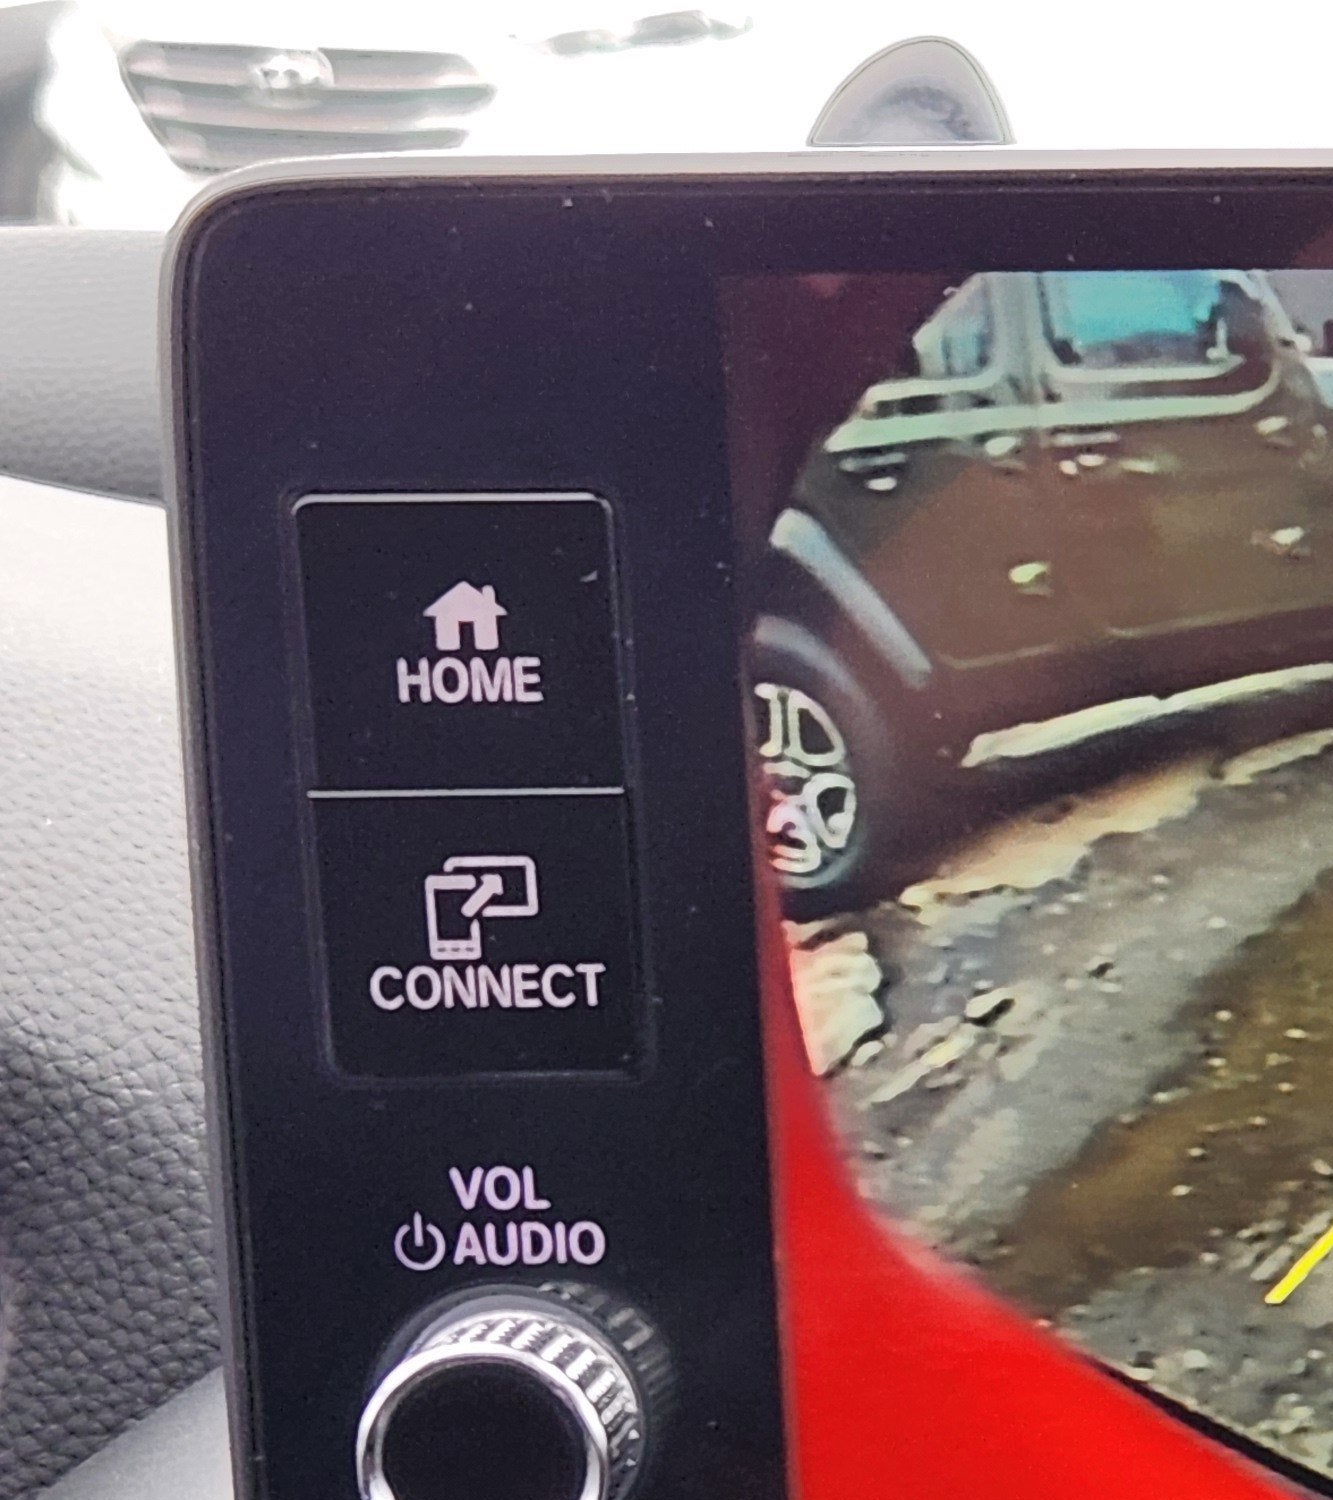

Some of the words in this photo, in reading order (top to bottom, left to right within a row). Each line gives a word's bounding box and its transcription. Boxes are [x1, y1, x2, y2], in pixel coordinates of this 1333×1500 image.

[396, 656, 544, 704] HOME
[369, 963, 606, 1011] CONNECT
[448, 1165, 552, 1211] VOL
[453, 1221, 606, 1266] AUDIO
